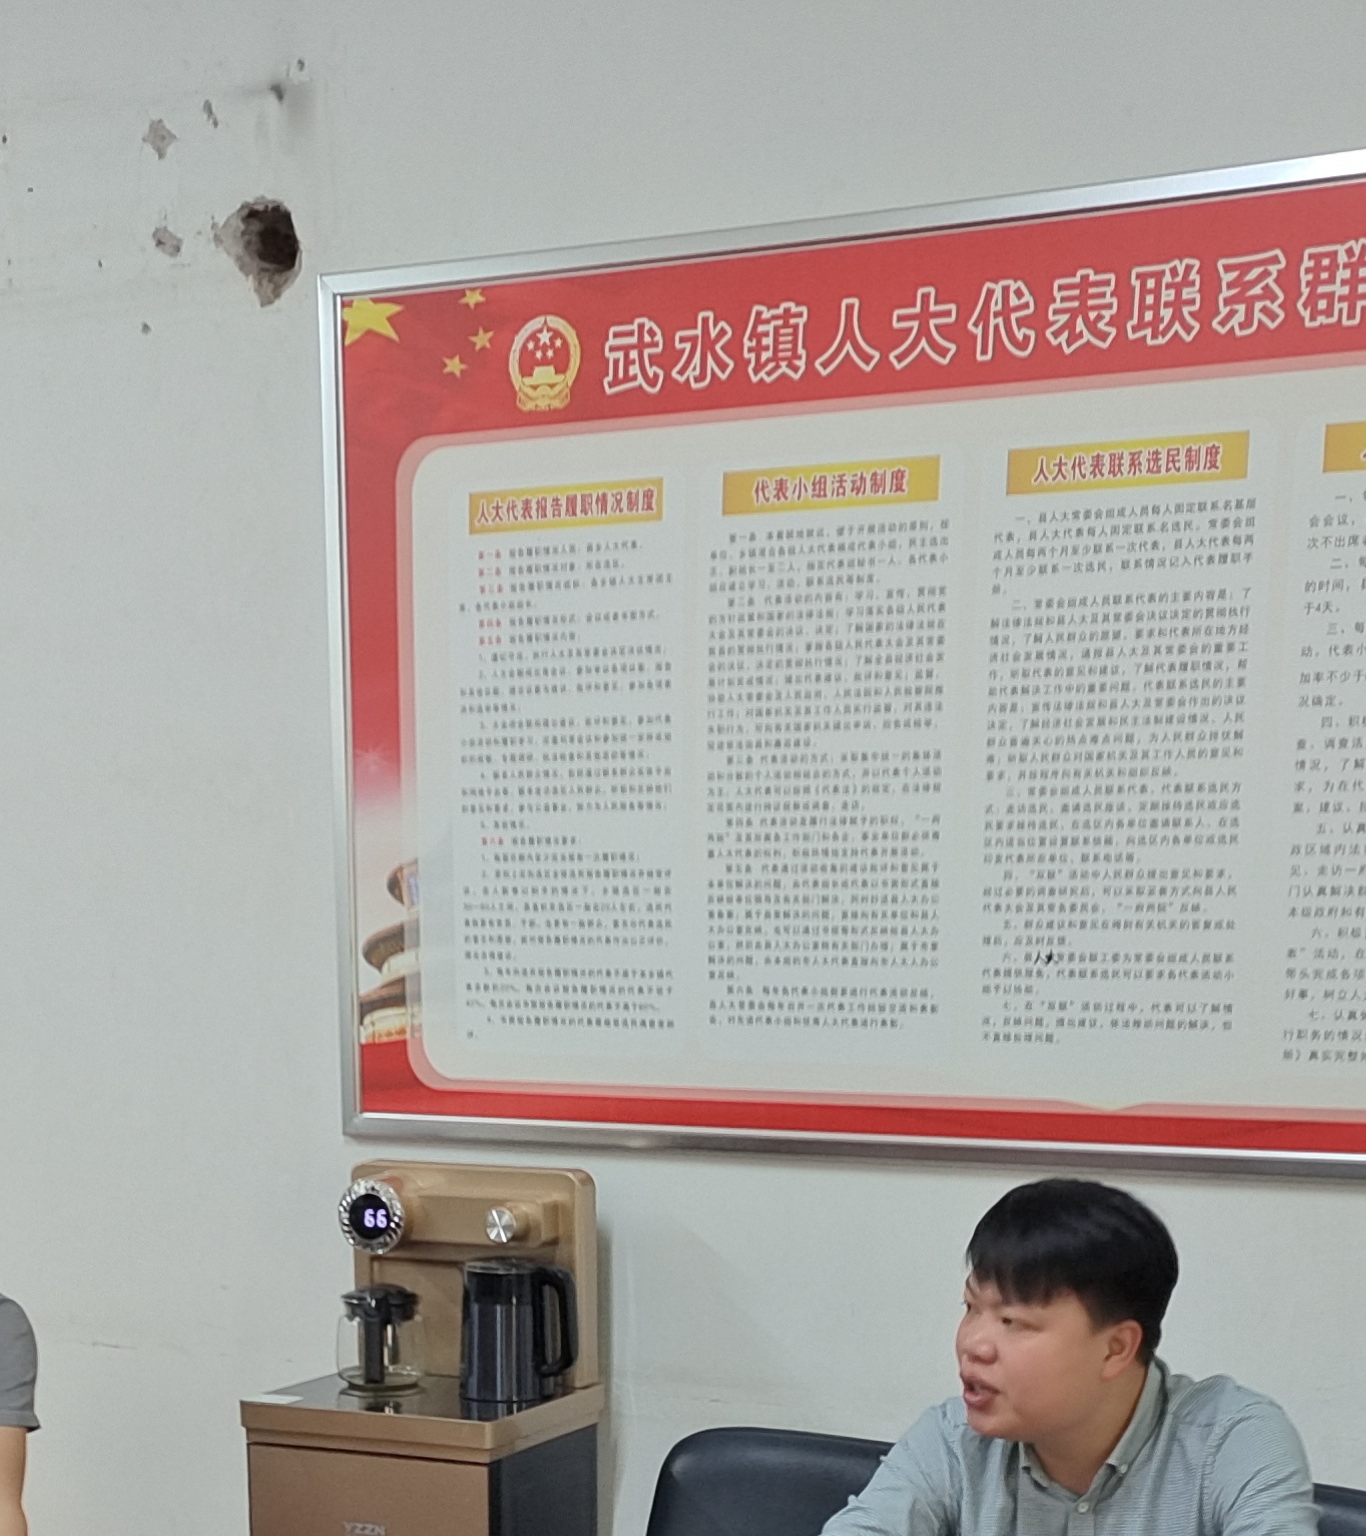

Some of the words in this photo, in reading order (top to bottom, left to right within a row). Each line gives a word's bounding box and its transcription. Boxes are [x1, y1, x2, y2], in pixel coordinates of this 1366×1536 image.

[1034, 443, 1221, 484] 人大代表联系选民制度
[754, 468, 907, 503] 代表小组活动制度
[477, 488, 654, 524] 人大代表报告履职情况制度
[363, 1207, 388, 1229] 66
